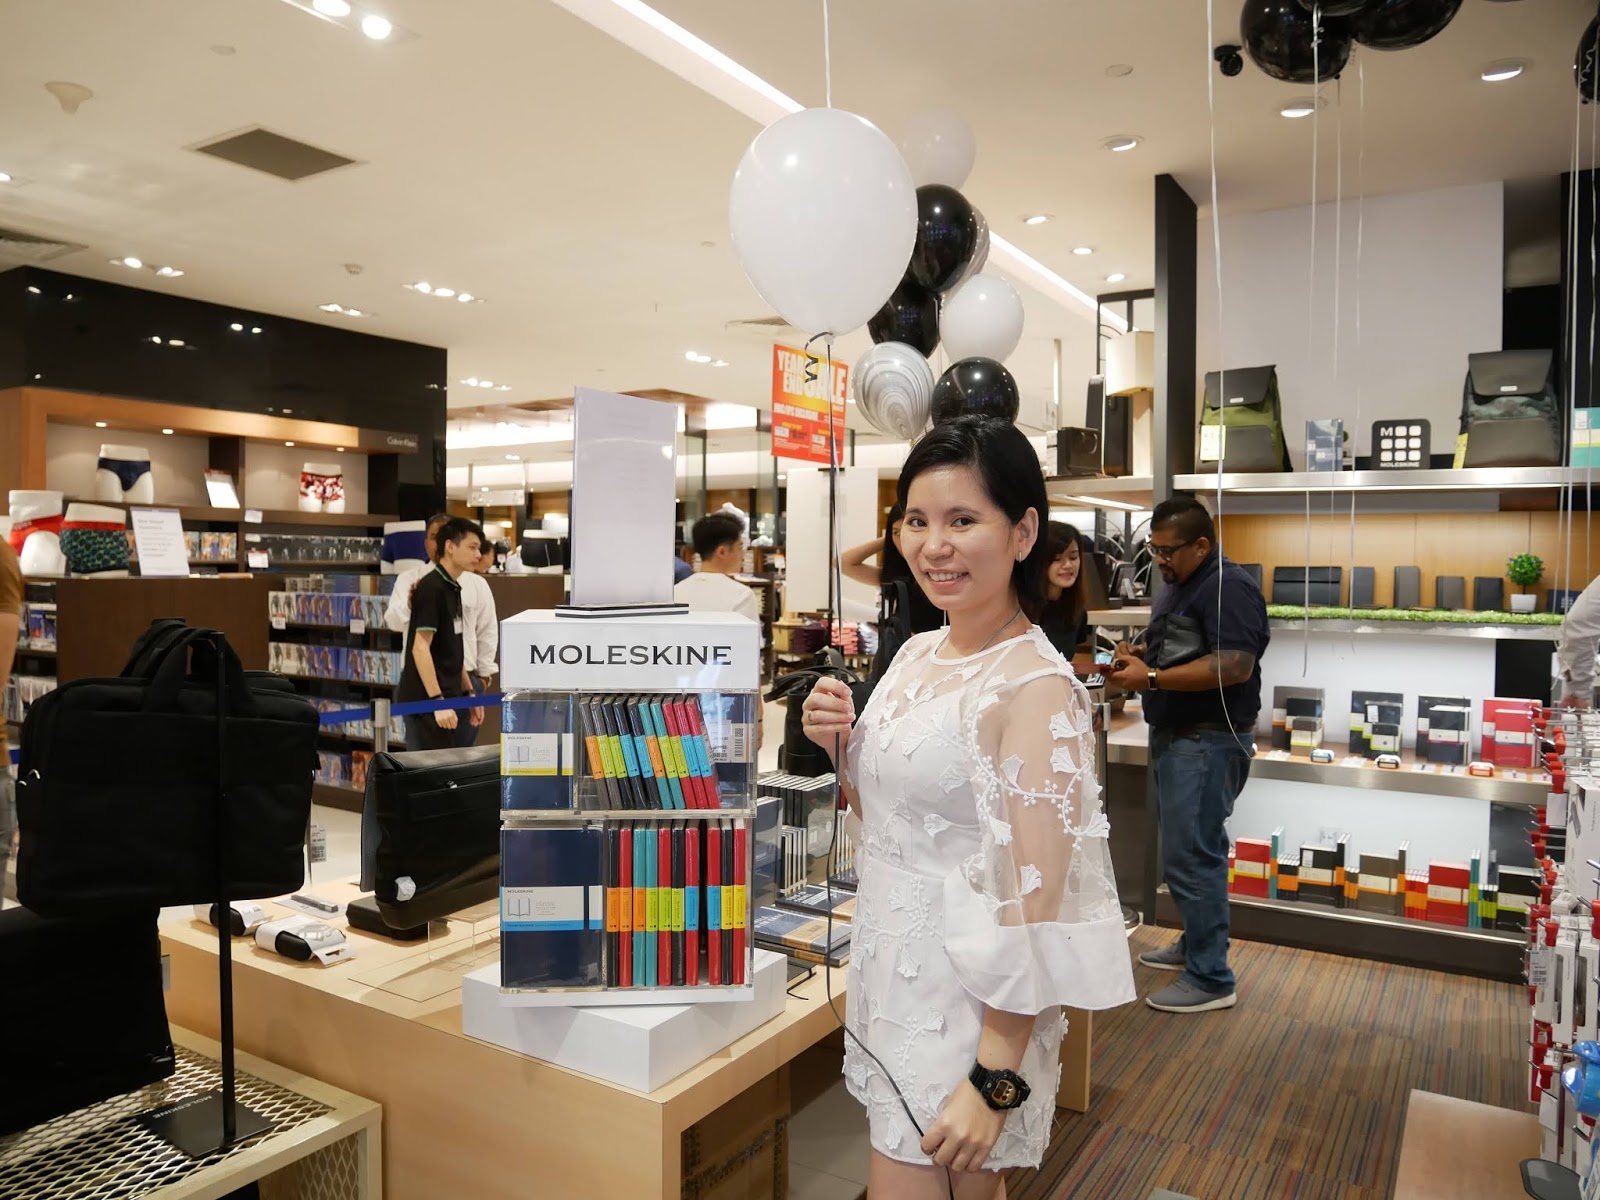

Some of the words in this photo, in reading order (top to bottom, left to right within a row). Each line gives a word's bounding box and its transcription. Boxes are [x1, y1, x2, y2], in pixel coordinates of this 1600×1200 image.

[777, 349, 804, 377] YEAR
[804, 356, 846, 404] SALE
[1380, 427, 1393, 437] M
[529, 645, 732, 665] MOLESKINE
